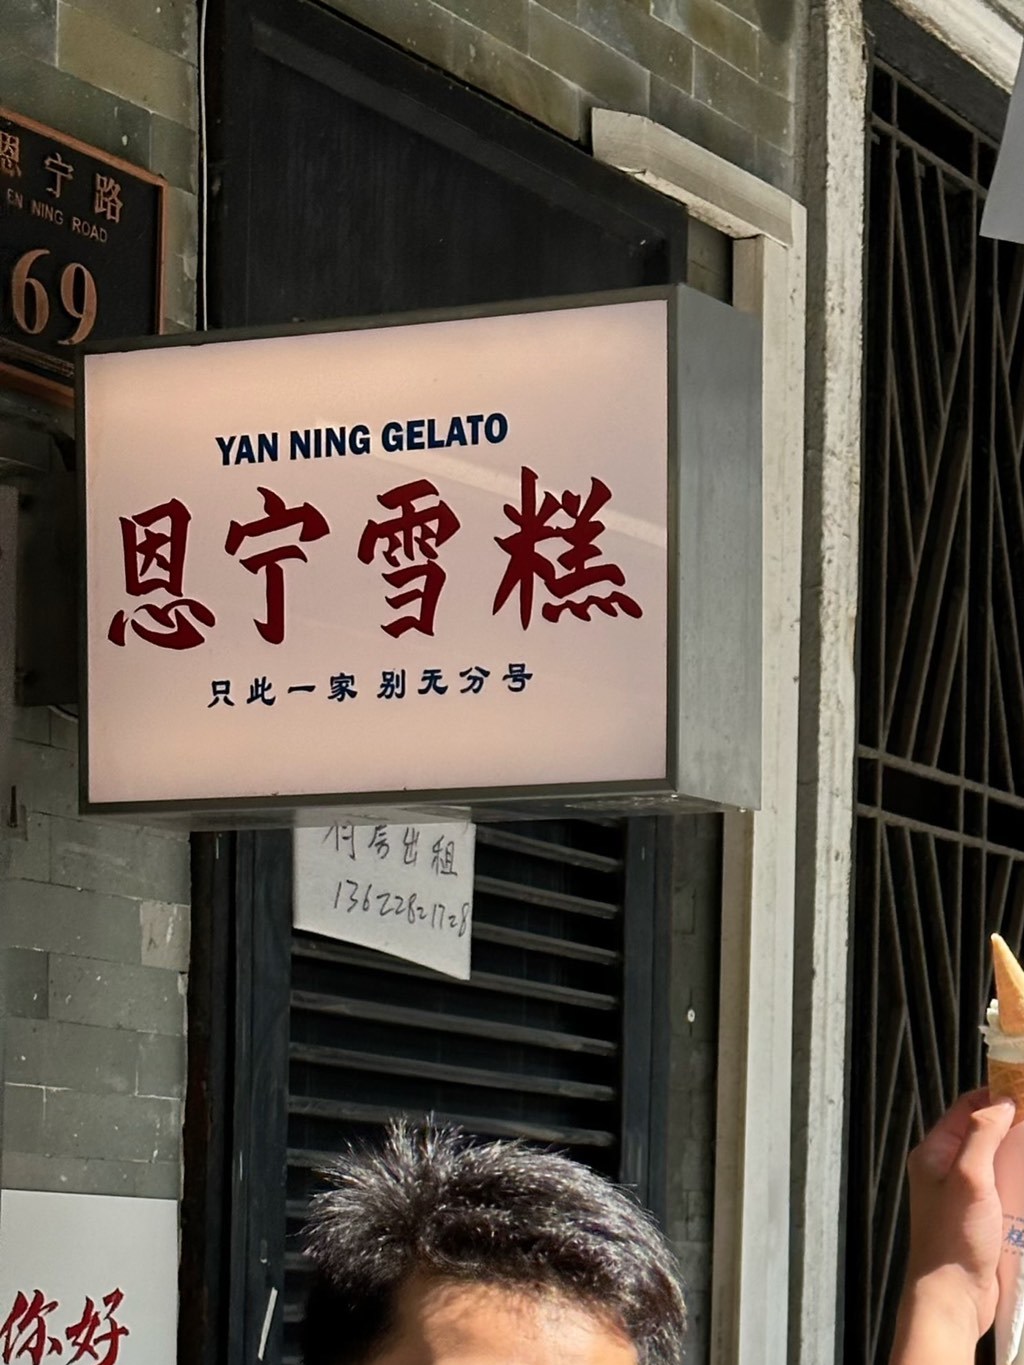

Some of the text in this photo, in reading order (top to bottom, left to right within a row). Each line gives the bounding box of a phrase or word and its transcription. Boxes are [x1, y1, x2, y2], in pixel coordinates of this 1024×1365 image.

[31, 200, 64, 225] NING
[72, 216, 108, 243] ROAD
[12, 249, 97, 345] 69
[215, 412, 508, 466] YAN NING GELATO
[108, 466, 643, 651] 恩宁雪糕
